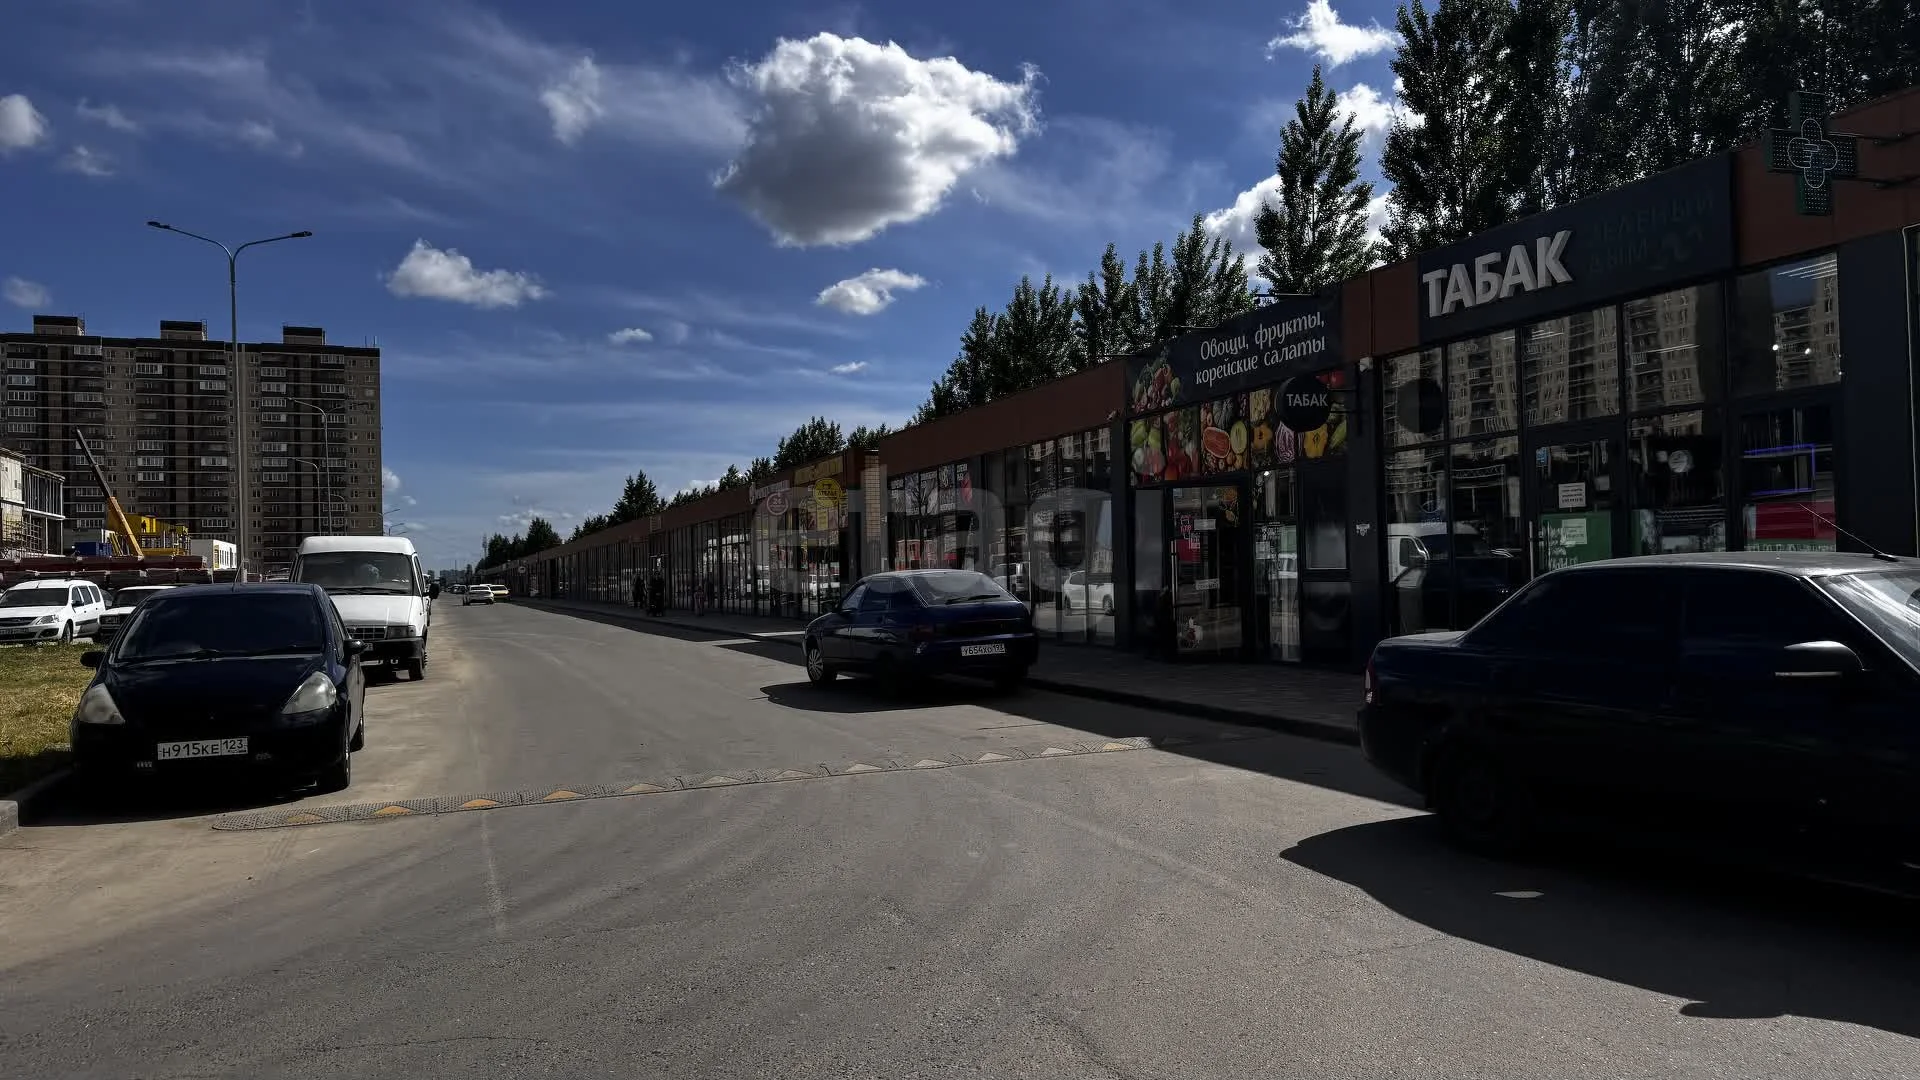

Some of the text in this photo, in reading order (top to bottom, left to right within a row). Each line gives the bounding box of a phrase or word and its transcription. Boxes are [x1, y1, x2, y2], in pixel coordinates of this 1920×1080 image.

[1423, 230, 1574, 318] ТАБАК
[1200, 311, 1325, 360] Овощи, фрукты,
[1195, 336, 1326, 388] корейские салаты
[1286, 393, 1329, 407] ТАБАК
[223, 740, 243, 750] 123
